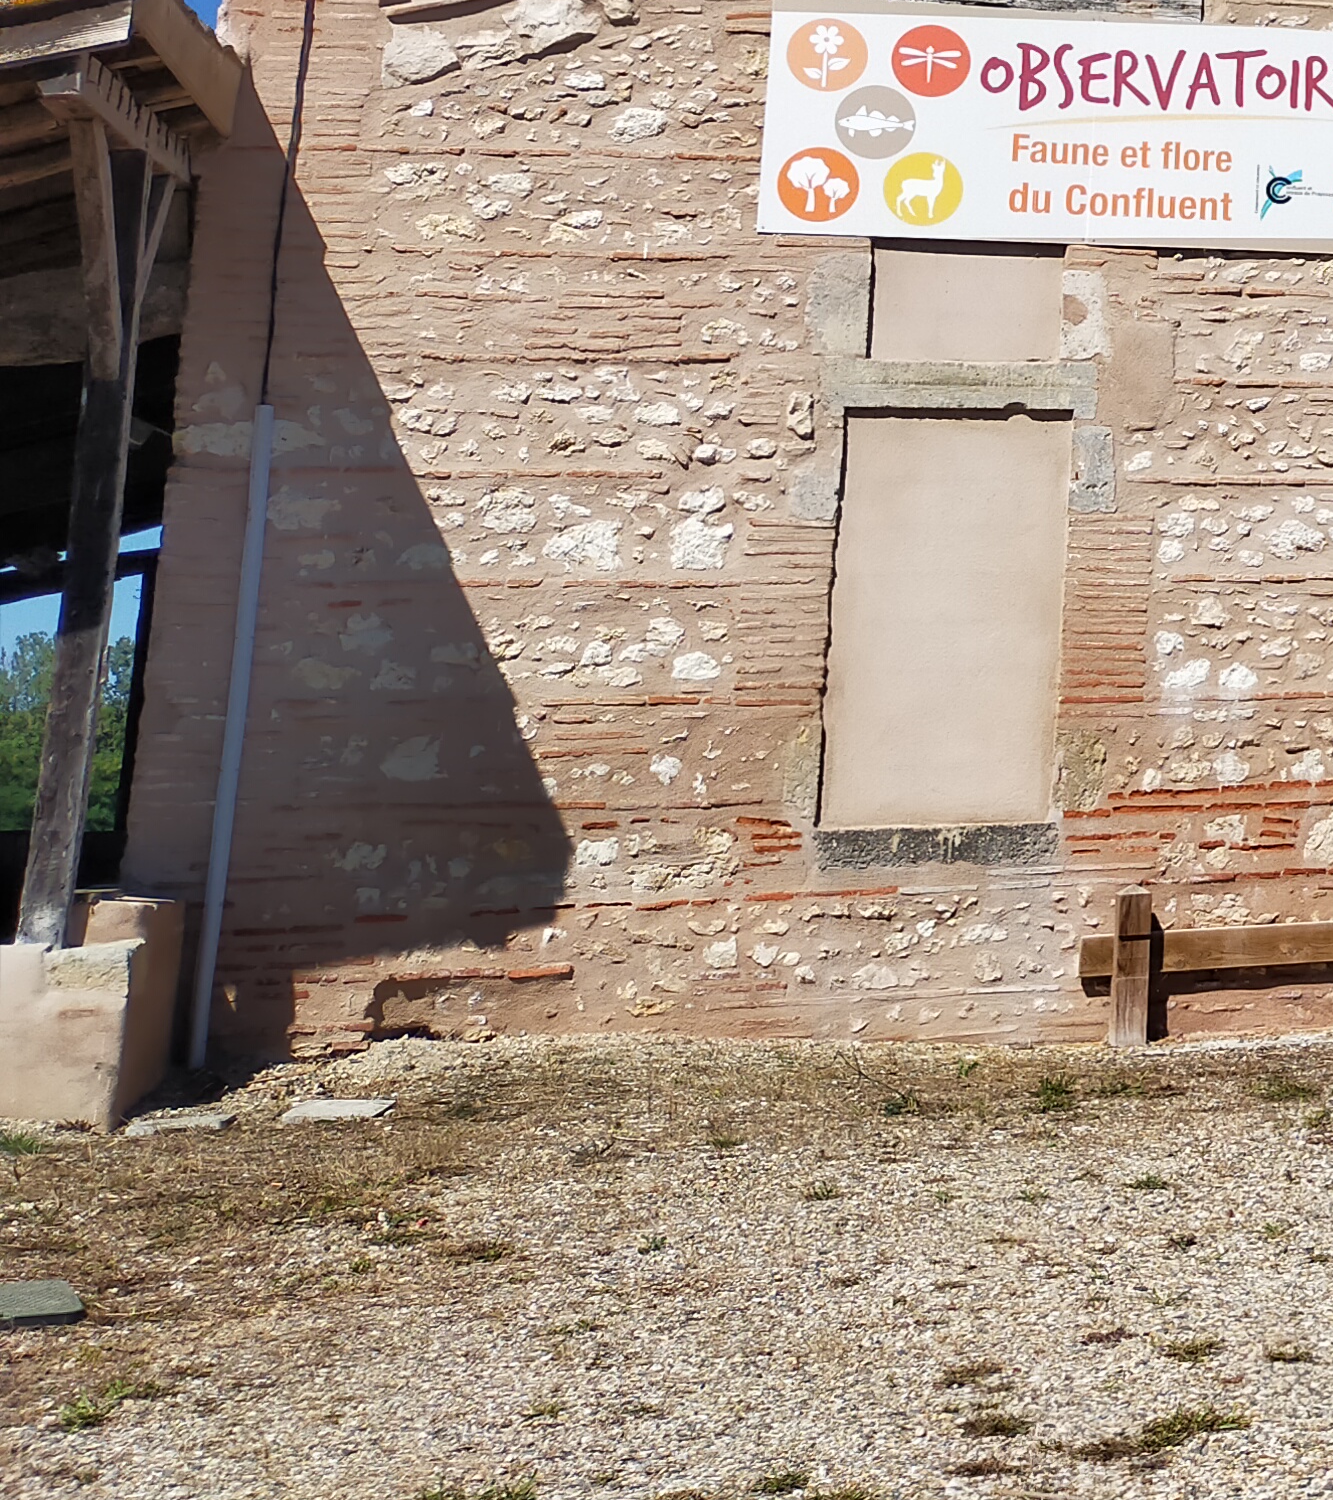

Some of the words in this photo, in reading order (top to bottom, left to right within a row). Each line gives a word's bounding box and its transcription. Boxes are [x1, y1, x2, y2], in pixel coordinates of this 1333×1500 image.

[1011, 133, 1109, 166] Faune
[1120, 141, 1149, 168] et
[1161, 141, 1232, 172] flore
[1008, 182, 1051, 214] du
[1065, 184, 1232, 221] Confluent
